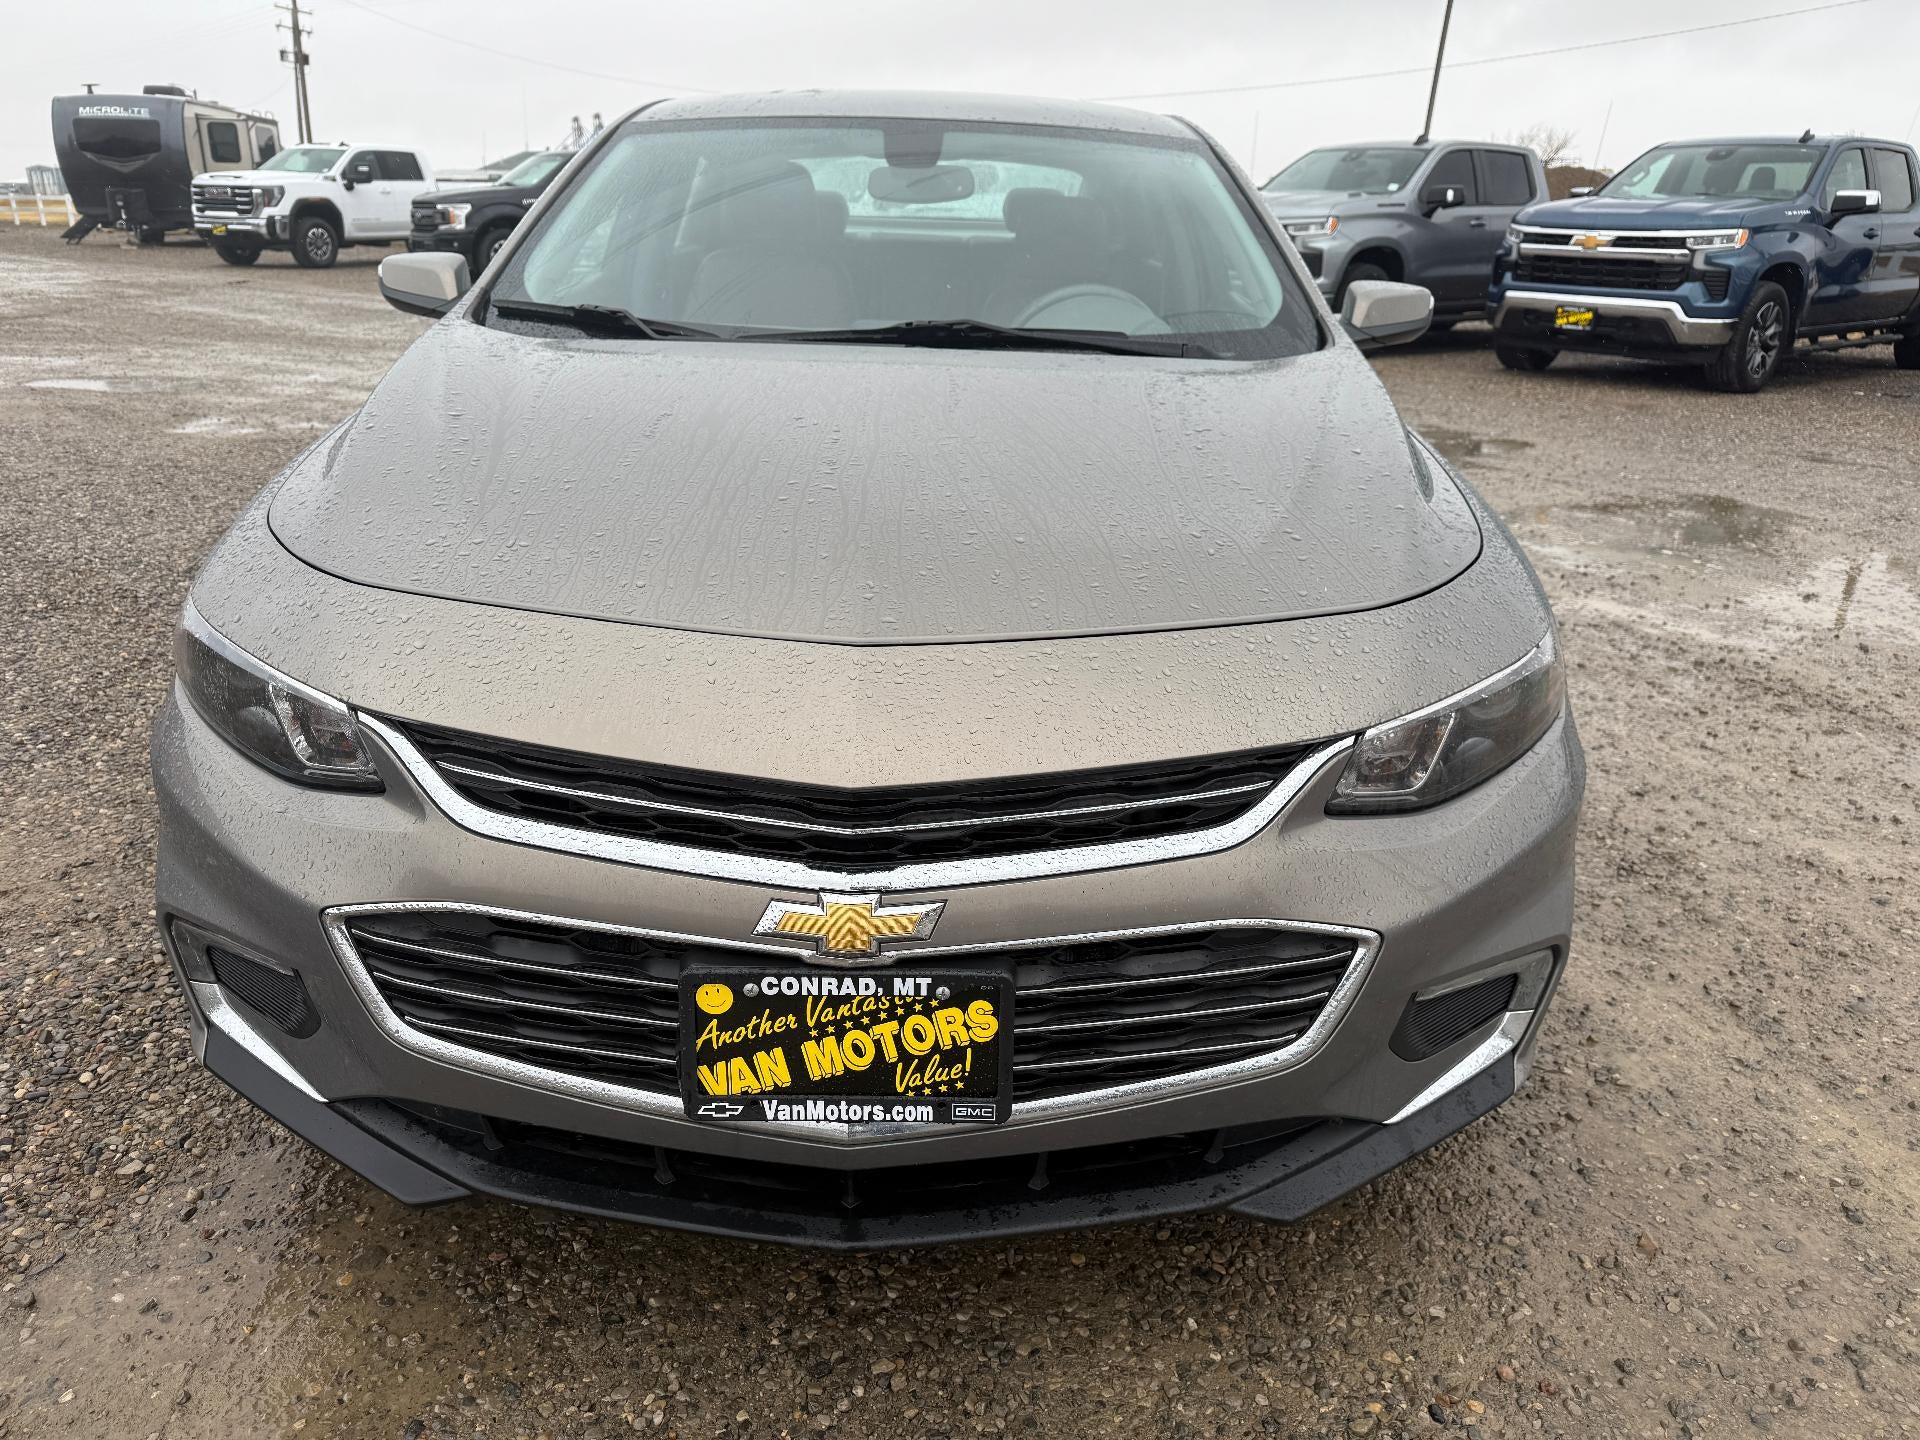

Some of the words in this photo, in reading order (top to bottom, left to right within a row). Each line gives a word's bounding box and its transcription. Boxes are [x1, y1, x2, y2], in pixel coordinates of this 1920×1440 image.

[761, 976, 883, 996] CONRAD,
[893, 977, 932, 996] MT
[696, 1008, 798, 1052] Another
[697, 1047, 792, 1096] VAN
[801, 1000, 999, 1082] MOTORS
[895, 1048, 972, 1093] Value!
[762, 1099, 934, 1122] VanMotors.com
[955, 1107, 993, 1117] GMC
